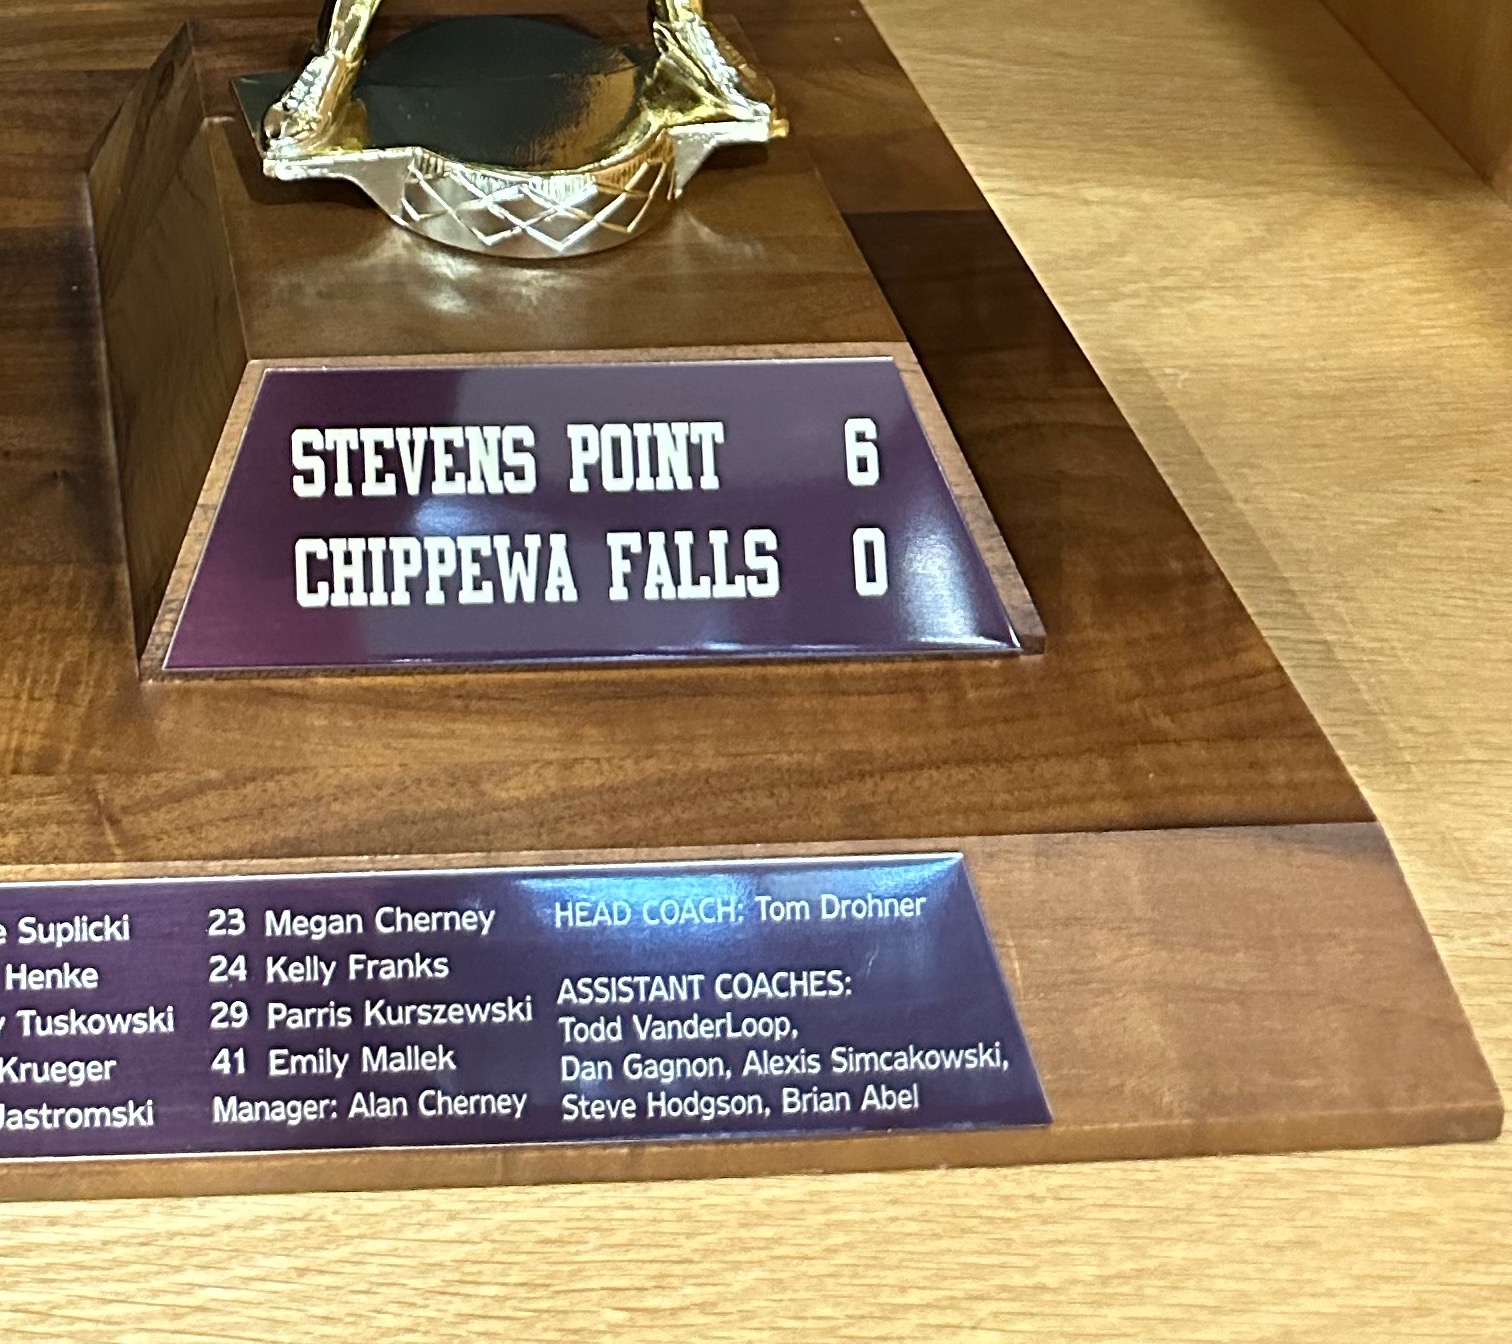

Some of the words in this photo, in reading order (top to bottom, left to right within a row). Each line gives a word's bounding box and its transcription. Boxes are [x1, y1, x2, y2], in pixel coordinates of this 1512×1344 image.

[290, 425, 537, 498] STEVENS
[567, 421, 725, 493] POINT
[843, 417, 880, 488] 6
[293, 532, 578, 608] CHIPPEWA
[607, 529, 779, 600] FALLS
[852, 527, 888, 597] 0
[207, 909, 246, 936] 23
[265, 910, 362, 940] Megan
[374, 906, 496, 938] Cherney
[555, 901, 631, 928] HEAD
[642, 899, 745, 926] COACH:
[754, 897, 809, 922] Tom
[820, 894, 926, 919] Drohner
[17, 915, 130, 948] Suplicki
[5, 963, 99, 991] Henke
[209, 955, 247, 982] 24
[266, 956, 338, 987] Kelly
[348, 953, 449, 981] Franks
[557, 974, 704, 1004] ASSISTANT
[714, 970, 853, 999] COACHES:
[16, 1007, 174, 1036] Tuskowski
[210, 1001, 249, 1029] 29
[267, 1002, 353, 1030] Parris
[364, 997, 533, 1026] Kurszewski
[560, 1016, 621, 1042] Todd
[632, 1013, 799, 1040] VanderLoop,
[212, 1048, 246, 1074] 41
[269, 1048, 348, 1078] Emily
[361, 1046, 457, 1073] Mallek
[561, 1055, 612, 1082] Dan
[623, 1053, 732, 1082] Gagnon,
[742, 1049, 820, 1076] Alexis
[831, 1042, 1009, 1071] Simcakowski,
[213, 1094, 337, 1126] Manager:
[348, 1092, 409, 1119] Alan
[418, 1091, 527, 1120] Cherney
[562, 1094, 636, 1121] Steve
[647, 1092, 770, 1120] Hodgson,
[782, 1088, 850, 1114] Brian
[861, 1085, 918, 1110] Abel
